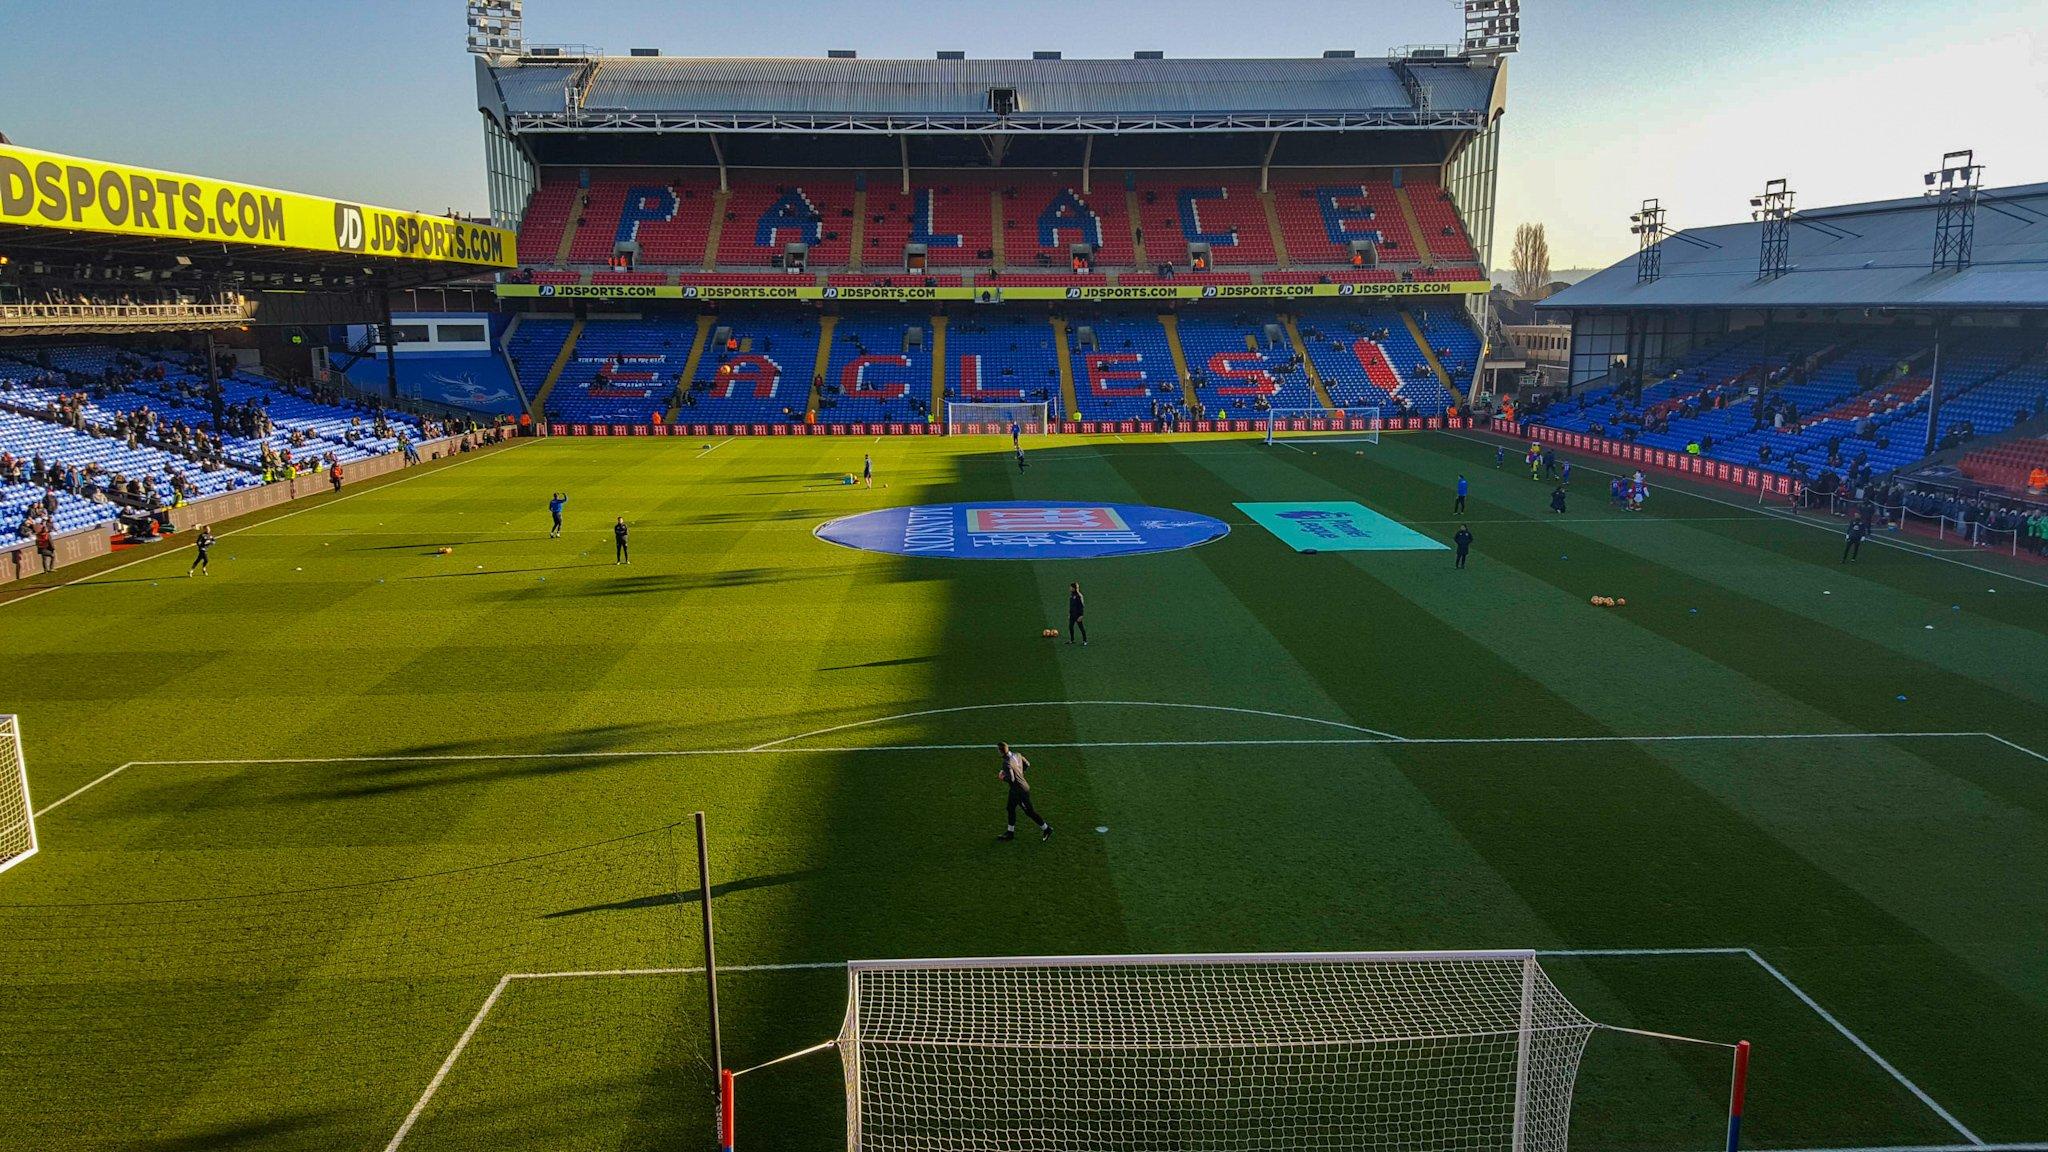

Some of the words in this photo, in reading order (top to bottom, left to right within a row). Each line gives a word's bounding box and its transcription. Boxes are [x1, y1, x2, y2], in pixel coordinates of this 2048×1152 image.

[339, 207, 363, 249] JD
[371, 213, 503, 263] JDSPORTS.COM
[614, 185, 1384, 248] PALACE
[540, 286, 554, 295] JD
[558, 286, 656, 296] JDSPORTS.COM
[684, 287, 696, 297] JD
[700, 287, 797, 297] JDSPORTS.COM
[824, 288, 836, 297] JD
[841, 288, 936, 298] JDSPORTS.COM
[1068, 288, 1080, 297] JD
[1084, 288, 1177, 298] JDSPORTS.COM
[1203, 287, 1216, 296] JD
[1220, 286, 1313, 296] JDSPORTS.COM
[1340, 285, 1352, 294] JD
[1357, 284, 1450, 294] JDSPORTS.COM
[903, 506, 954, 552] MANSION
